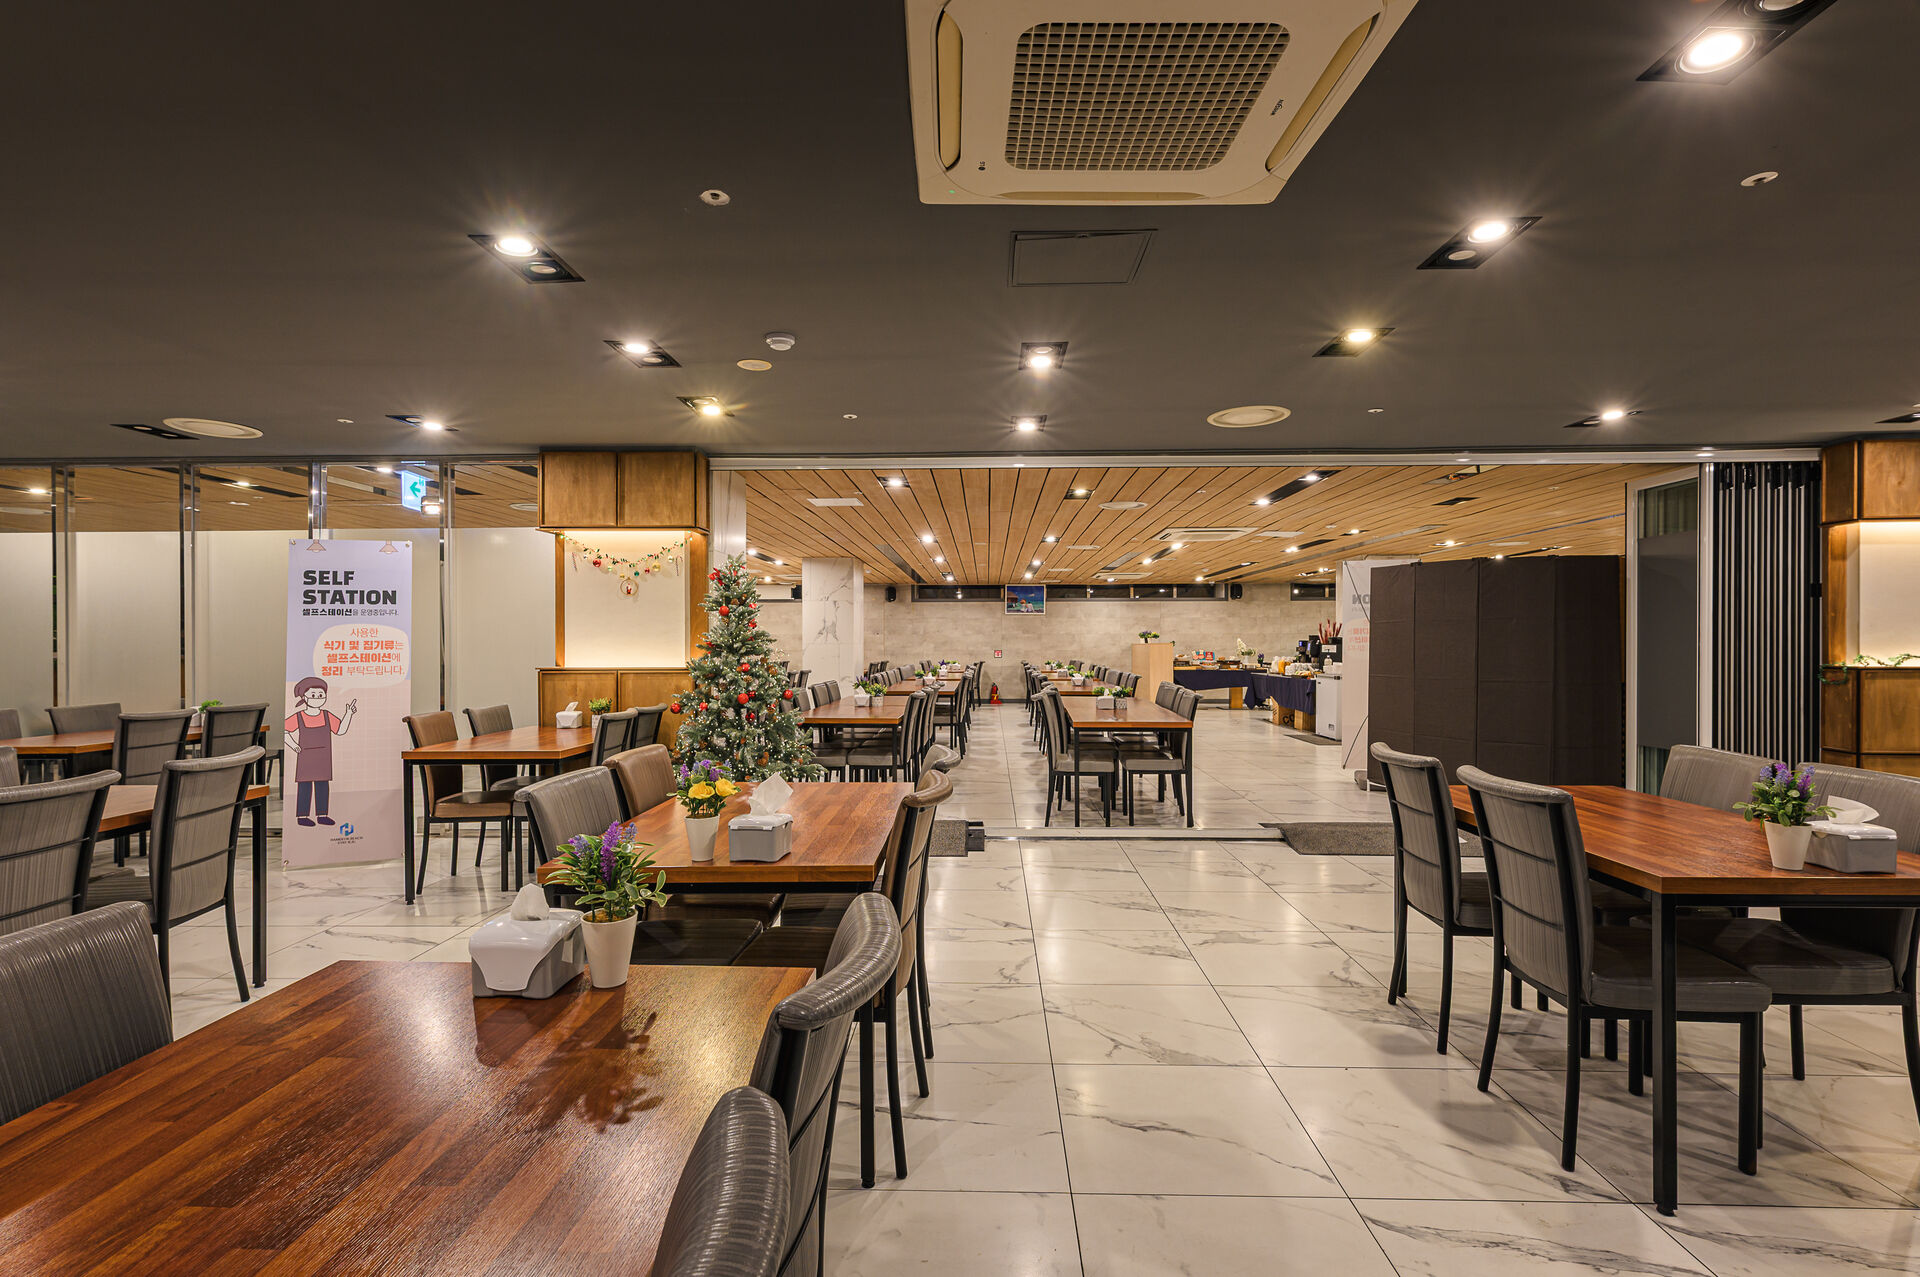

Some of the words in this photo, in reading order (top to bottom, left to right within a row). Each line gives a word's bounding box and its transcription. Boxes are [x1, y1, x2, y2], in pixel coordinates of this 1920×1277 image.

[303, 570, 355, 585] SELF
[302, 589, 397, 605] STATION
[302, 608, 358, 616] 셀프스테이션을
[350, 627, 379, 638] 사용한
[323, 640, 345, 651] 식기
[349, 640, 359, 651] 및
[363, 640, 405, 651] 집기류는
[327, 652, 401, 664] 셀프스테이션에
[321, 665, 343, 677] 정리
[347, 664, 405, 676] 부탁드립니다.
